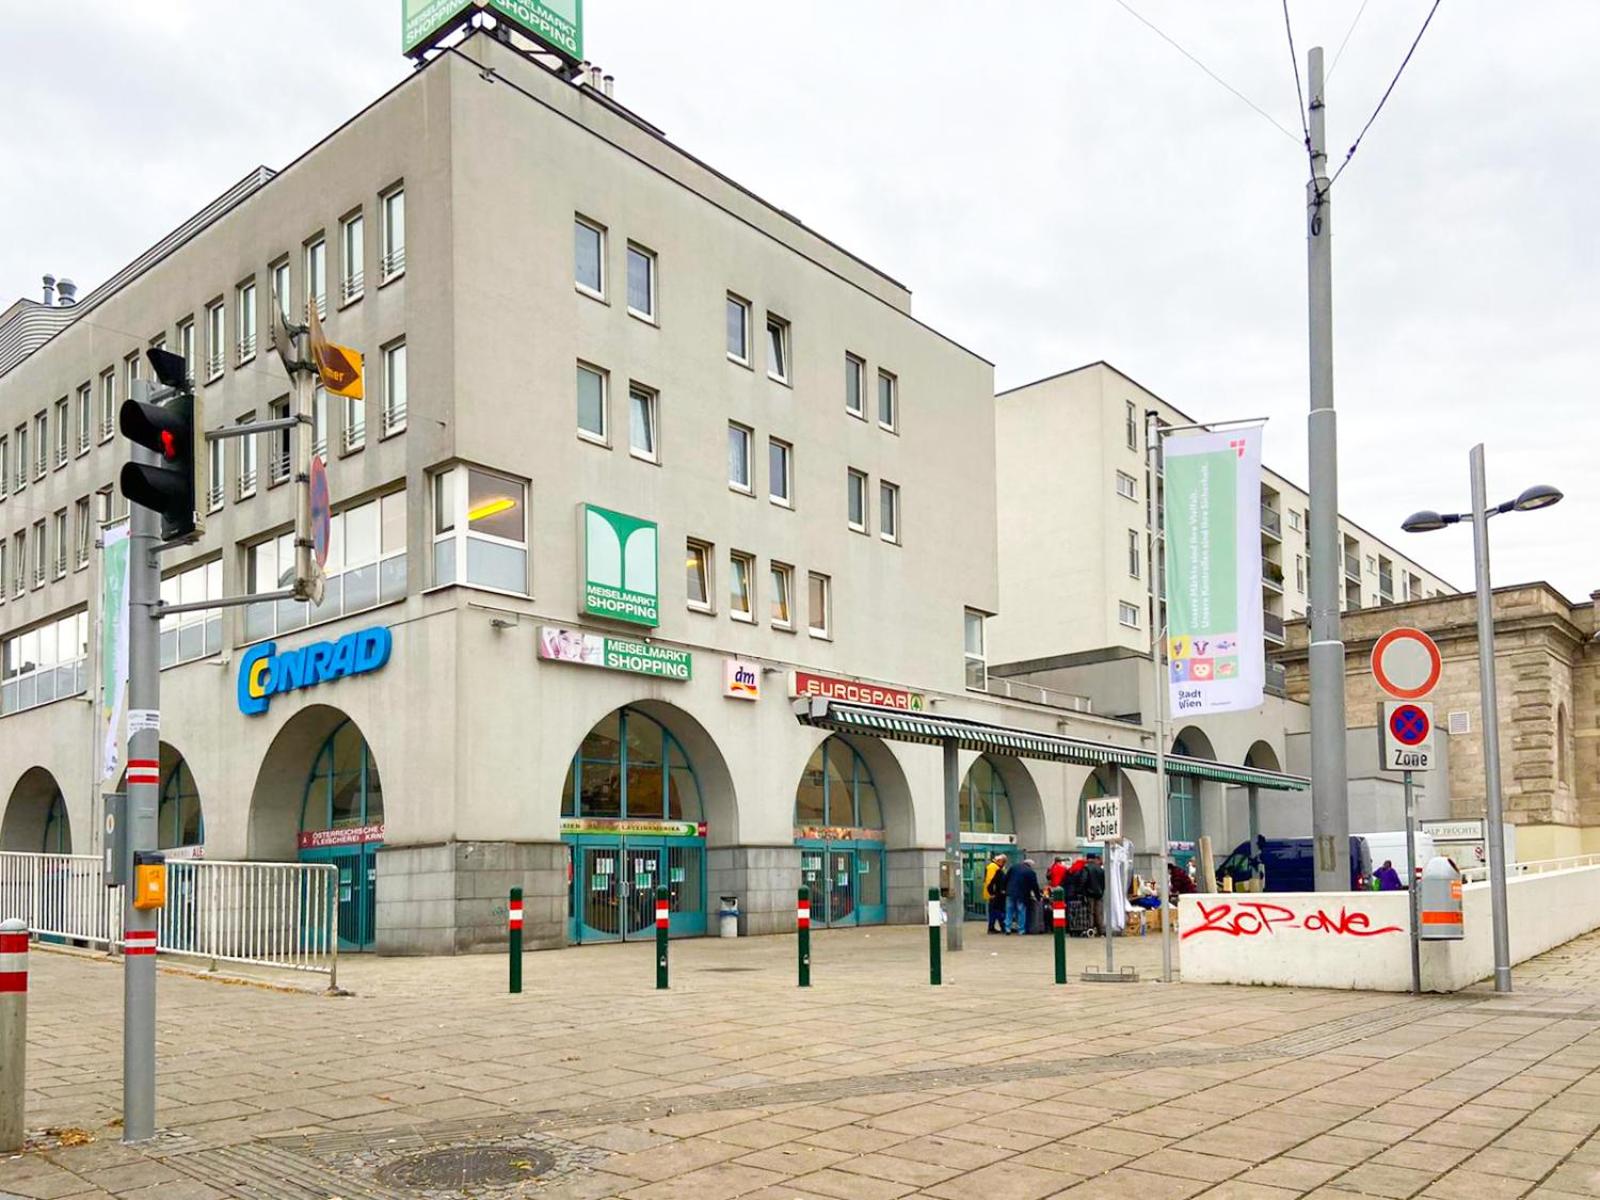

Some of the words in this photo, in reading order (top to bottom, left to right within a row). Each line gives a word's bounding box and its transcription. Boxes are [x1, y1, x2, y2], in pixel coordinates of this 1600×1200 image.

[587, 585, 656, 606] MEISELMARKT
[587, 595, 657, 618] SHOPPING
[607, 640, 688, 662] MEISELMARKT
[237, 626, 392, 715] CONRAD
[607, 653, 689, 677] SHOPPING
[735, 666, 755, 685] dm
[806, 679, 908, 709] EUROSPAR
[1178, 700, 1202, 710] Wien
[1395, 749, 1428, 767] Zone
[1089, 802, 1119, 818] Markt-
[1090, 820, 1118, 841] gebiet
